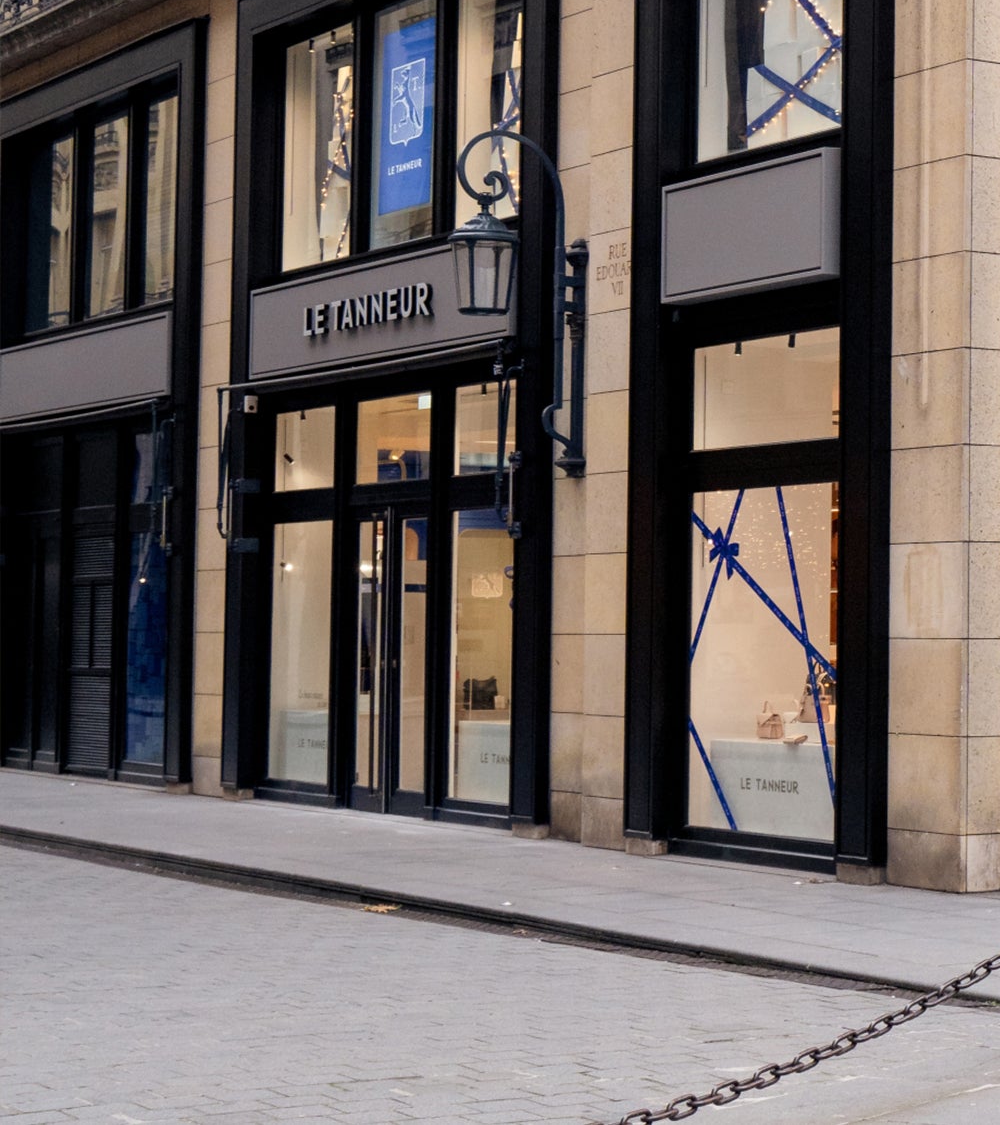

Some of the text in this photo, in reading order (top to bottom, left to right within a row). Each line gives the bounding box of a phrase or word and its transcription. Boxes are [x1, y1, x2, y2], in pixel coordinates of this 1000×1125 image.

[388, 158, 422, 176] LE TANNEUR
[609, 242, 627, 260] RUE
[611, 281, 624, 295] VII
[303, 282, 431, 336] LE TANNEUR
[740, 777, 799, 794] LE TANNEUR
